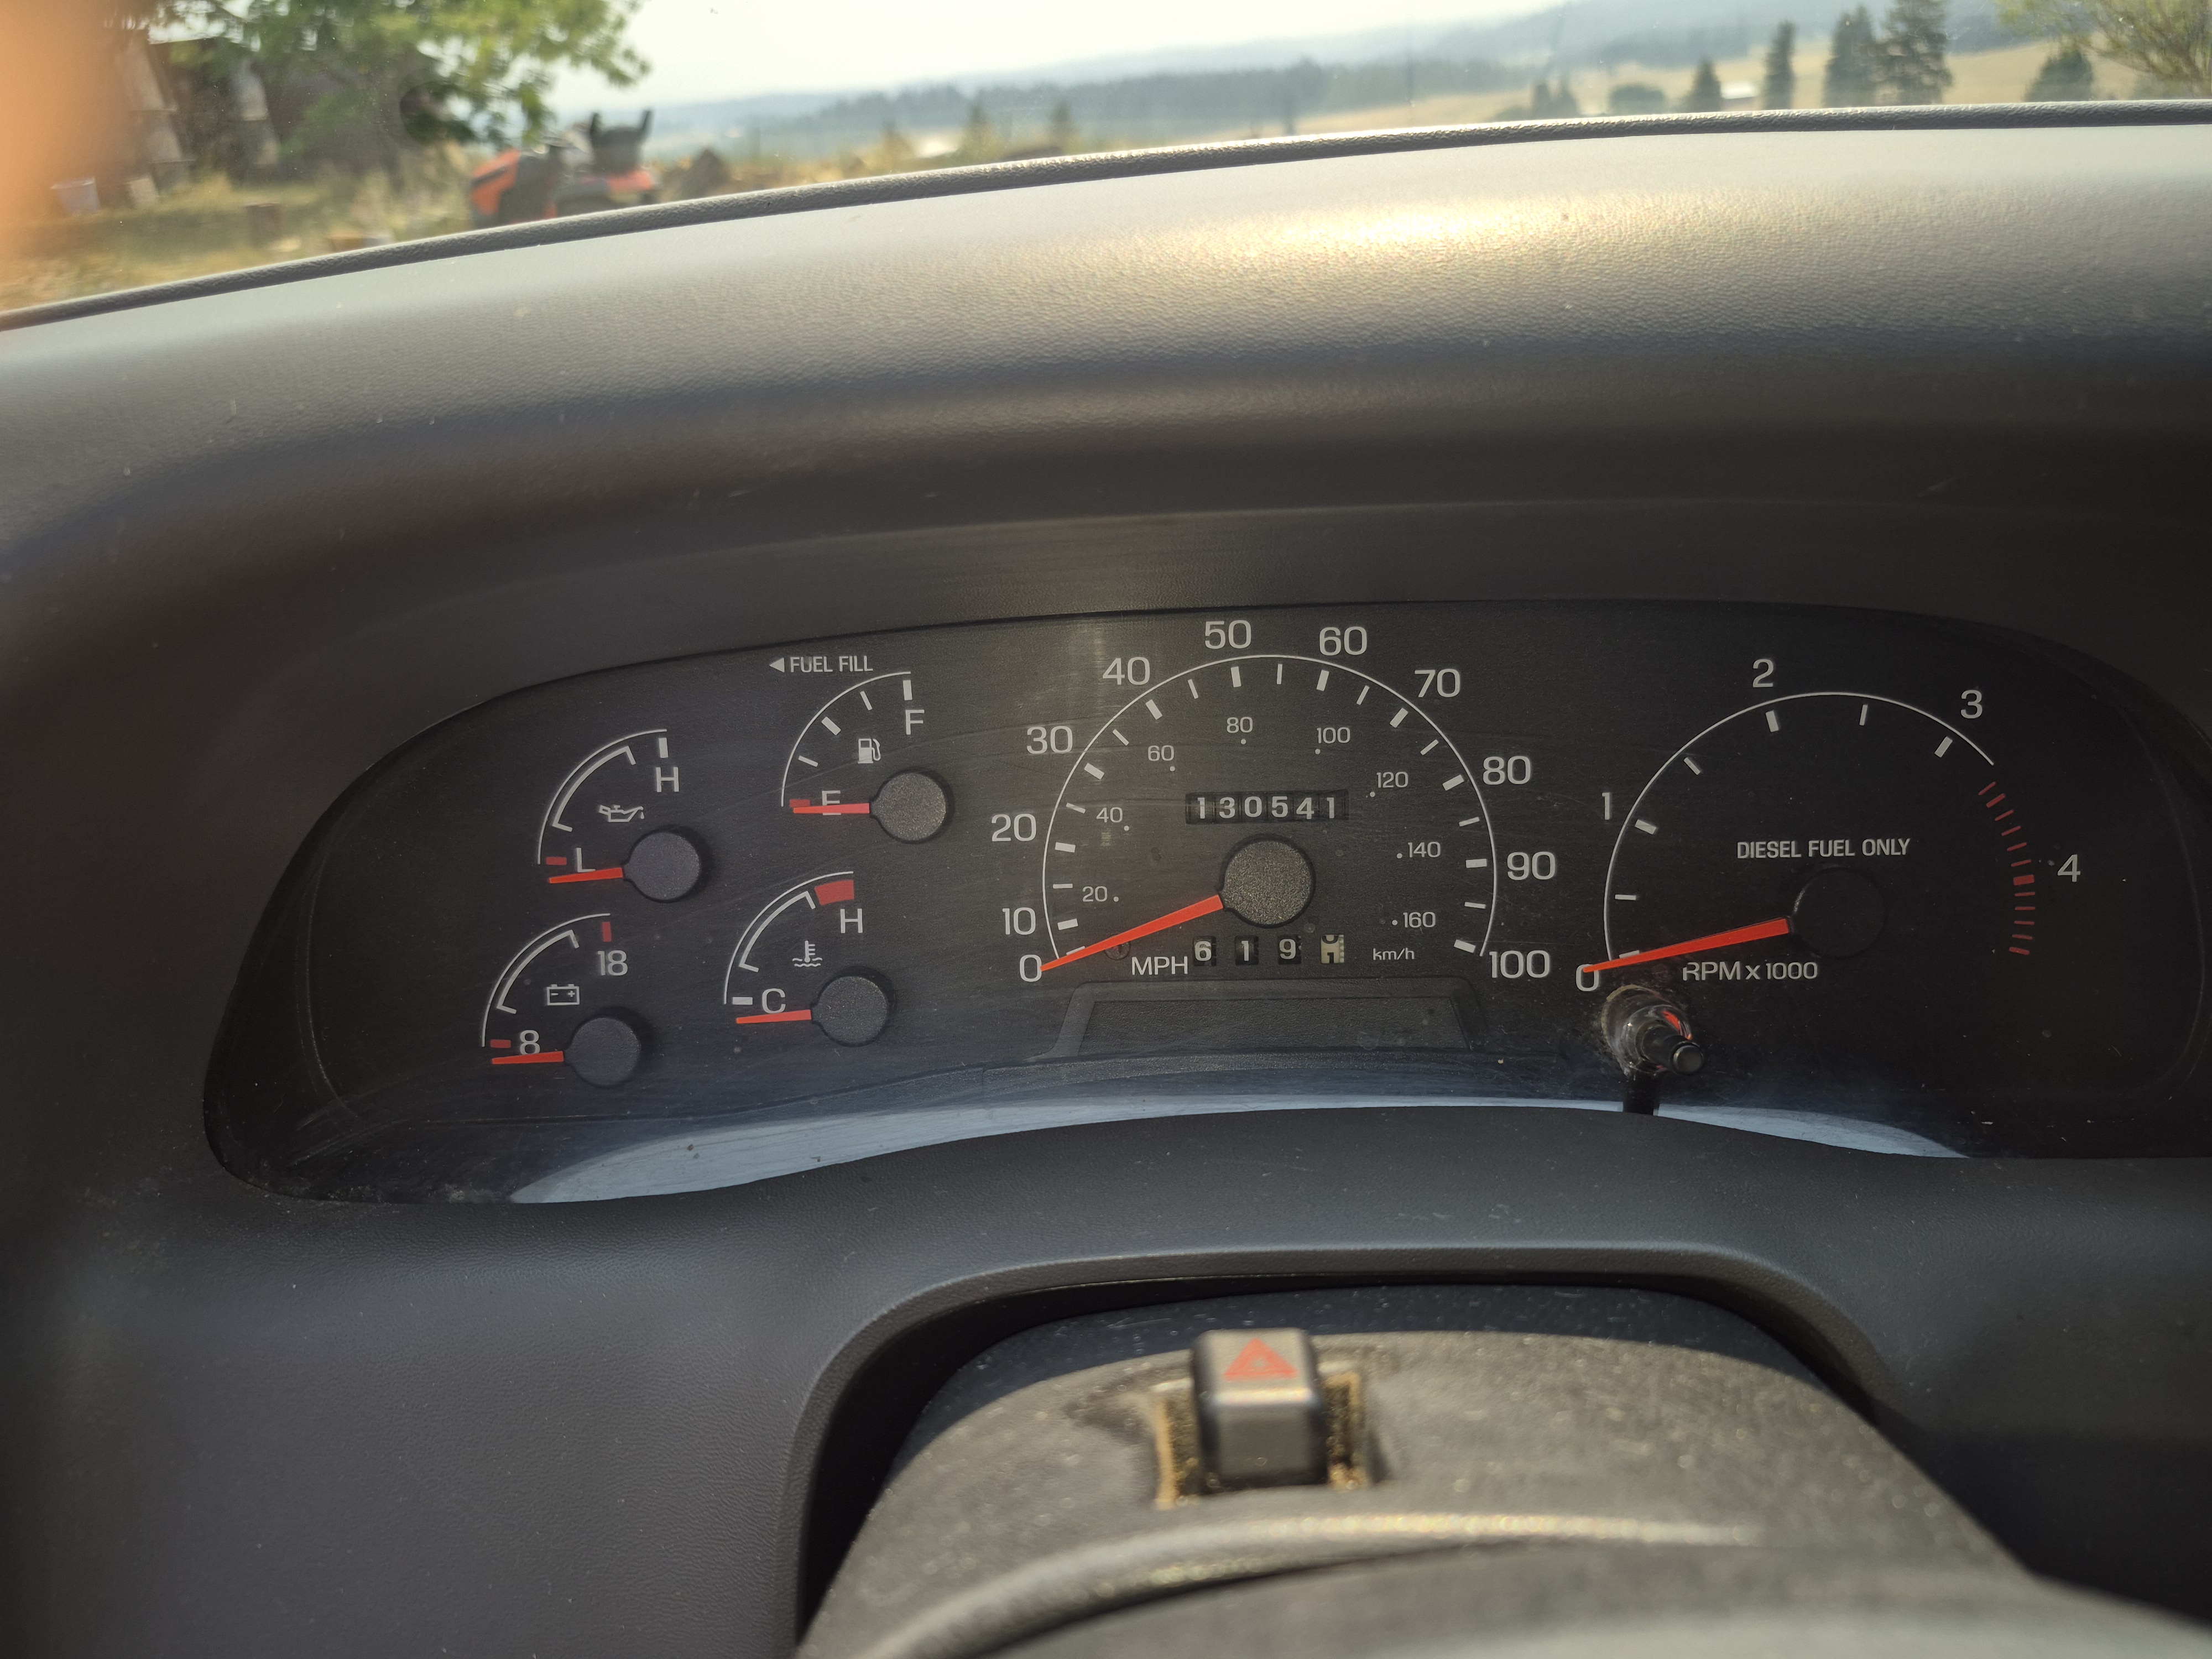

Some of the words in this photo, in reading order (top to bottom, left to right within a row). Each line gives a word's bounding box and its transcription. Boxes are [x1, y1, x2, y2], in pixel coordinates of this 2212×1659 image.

[1204, 620, 1252, 649] 50
[1319, 627, 1367, 655] 60
[790, 656, 833, 672] FUEL
[839, 655, 873, 672] FILL
[1103, 657, 1150, 685] 40
[1752, 659, 1773, 687] 2
[1415, 669, 1460, 697] 70
[1960, 690, 1983, 719] 3
[905, 709, 924, 735] F
[1227, 717, 1254, 733] 80
[1026, 726, 1072, 754] 30
[1317, 727, 1350, 743] 100
[1147, 745, 1174, 761] 60
[656, 767, 679, 792] H
[1376, 772, 1408, 788] 120
[1483, 756, 1531, 785] 80
[822, 791, 841, 815] E
[1096, 807, 1123, 823] 40
[1197, 796, 1334, 820] 130541
[1602, 792, 1610, 820] 1
[992, 813, 1036, 842] 20
[576, 848, 596, 872] L
[1408, 842, 1440, 858] 140
[1737, 841, 1801, 859] DIESEL
[1808, 839, 1855, 857] FUEL
[1862, 838, 1910, 856] ONLY
[1507, 852, 1555, 880] 90
[2058, 855, 2080, 882] 4
[1082, 886, 1108, 901] 20
[841, 909, 863, 933] H
[1003, 907, 1035, 935] 10
[1403, 912, 1436, 927] 160
[598, 951, 628, 975] 18
[1132, 956, 1188, 975] MPH
[1373, 948, 1415, 961] km/h
[1489, 950, 1550, 978] 100
[1020, 954, 1041, 982] 0
[1575, 964, 1599, 992] 0
[1683, 961, 1740, 981] RPM
[1766, 962, 1818, 979] 1000
[762, 988, 786, 1014] C
[520, 1030, 540, 1055] 8
